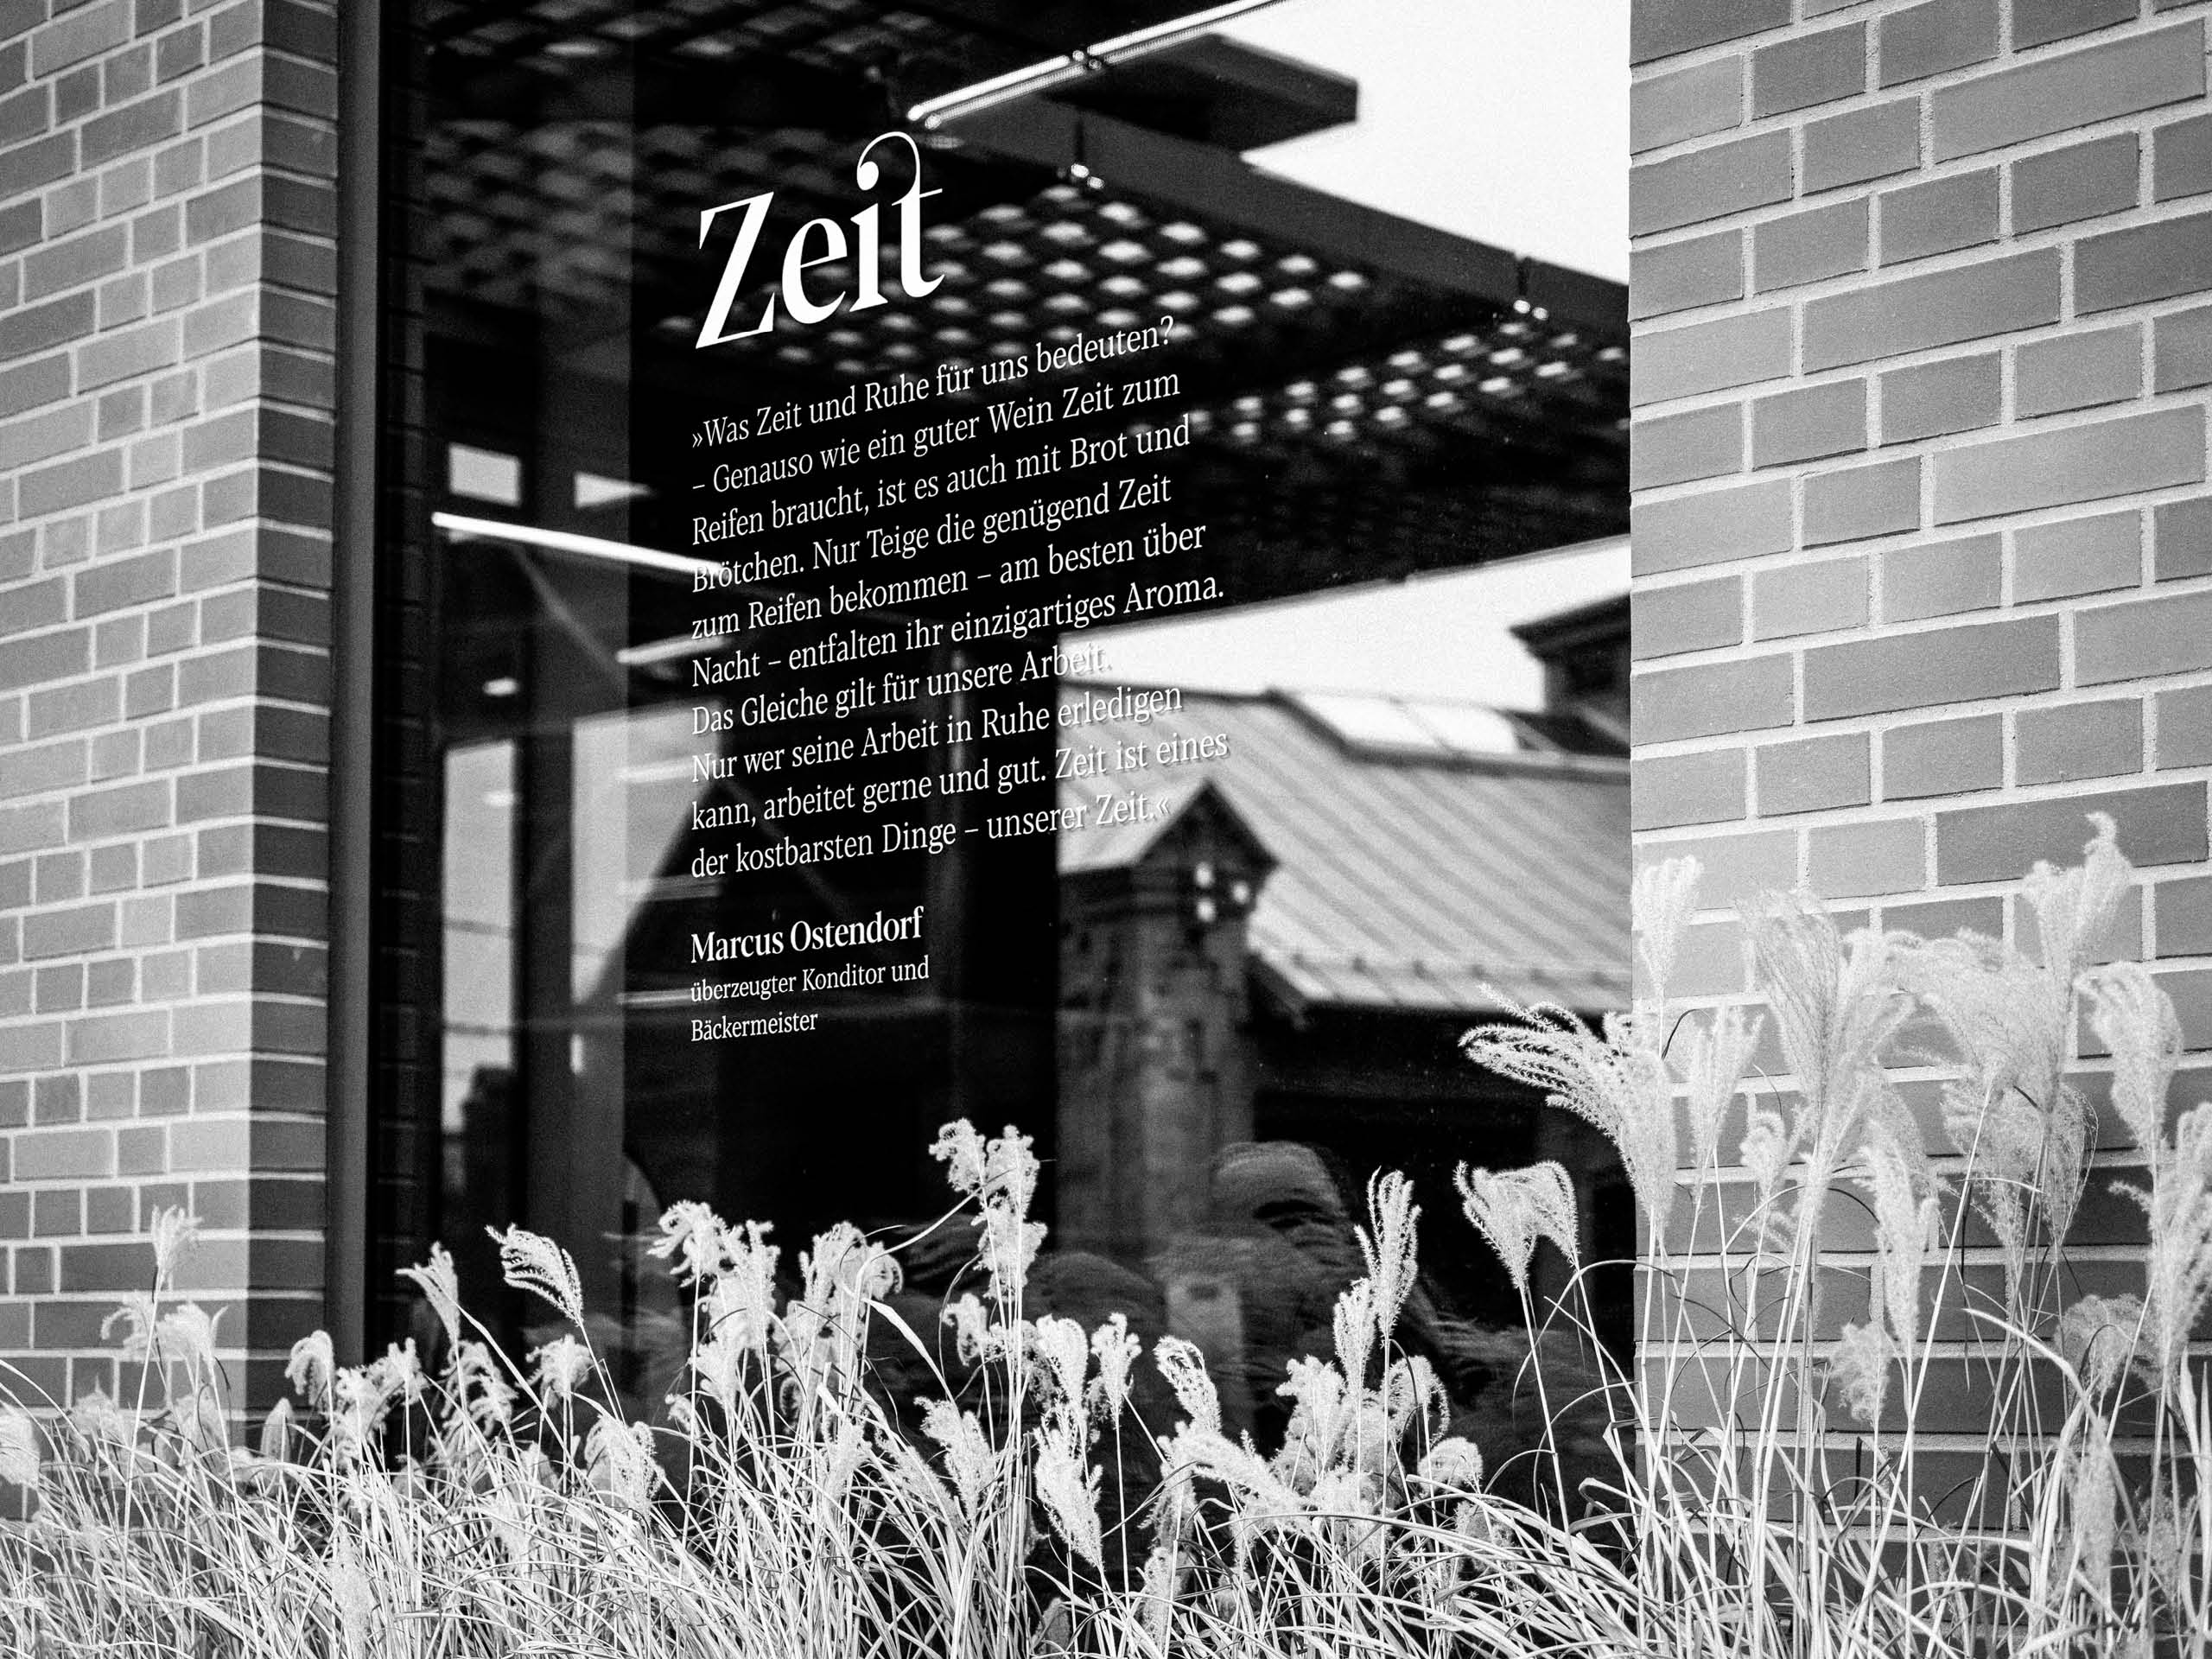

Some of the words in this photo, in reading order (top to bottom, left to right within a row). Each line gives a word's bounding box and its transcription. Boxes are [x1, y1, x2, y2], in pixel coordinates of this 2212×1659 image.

[696, 130, 945, 349] Zeit
[691, 417, 749, 449] »Was
[757, 402, 803, 435] Zeit
[810, 386, 857, 423] und
[864, 374, 930, 412] Ruhe
[936, 364, 974, 396] für
[982, 355, 1028, 385] uns
[1036, 315, 1175, 372] bedeuten?
[713, 454, 813, 493] Genauso
[820, 439, 861, 471] wie
[868, 429, 906, 459] ein
[912, 414, 980, 456] guter
[988, 397, 1053, 434] Wein
[1062, 383, 1114, 418] Zeit
[1122, 373, 1180, 404] zum
[692, 508, 764, 545] Reifen
[772, 487, 869, 529] braucht,
[878, 474, 906, 507] ist
[913, 473, 939, 497] es
[946, 454, 1007, 491] auch
[1015, 445, 1062, 480] mit
[1071, 433, 1128, 468] Brot
[1135, 415, 1191, 454] und
[691, 613, 740, 639] zum
[747, 594, 823, 629] Reifen
[830, 569, 969, 615] bekommen
[999, 556, 1039, 584] am
[1048, 538, 1135, 575] besten
[1143, 524, 1206, 555] über
[692, 552, 805, 593] Brötchen.
[812, 538, 861, 569] Nur
[867, 524, 930, 559] Teige
[937, 512, 975, 546] die
[982, 481, 1110, 543] genügend
[1118, 474, 1172, 510] Zeit
[692, 650, 760, 687] Nacht
[788, 629, 899, 670] entfalten
[906, 616, 944, 650] ihr
[950, 593, 1116, 642] einzigartiges
[1123, 575, 1224, 613] Aroma.
[692, 704, 734, 734] Das
[741, 690, 829, 726] Gleiche
[836, 677, 876, 718] gilt
[881, 673, 919, 706] für
[926, 662, 1013, 696] unsere
[1020, 642, 1113, 681] Arbeit.
[692, 753, 737, 783] Nur
[744, 748, 785, 774] wer
[792, 735, 854, 767] seine
[861, 720, 939, 757] Arbeit
[946, 714, 973, 744] in
[982, 702, 1050, 739] Ruhe
[1058, 686, 1182, 727] erledigen
[692, 800, 757, 830] kann,
[764, 783, 855, 821] arbeitet
[862, 779, 931, 813] gerne
[939, 762, 989, 795] und
[997, 755, 1046, 795] gut.
[1055, 745, 1104, 779] Zeit
[1115, 739, 1147, 771] ist
[1156, 730, 1228, 764] eines
[691, 849, 728, 879] der
[736, 832, 873, 872] kostbarsten
[882, 821, 957, 855] Dinge
[988, 804, 1090, 840] unserer
[1096, 791, 1169, 826] Zeit.«
[691, 931, 783, 963] Marcus
[791, 906, 924, 951] Ostendorf
[691, 976, 796, 1001] überzeugter
[802, 963, 886, 991] Konditor
[891, 955, 929, 982] und
[691, 1011, 818, 1041] Bäckermeister
